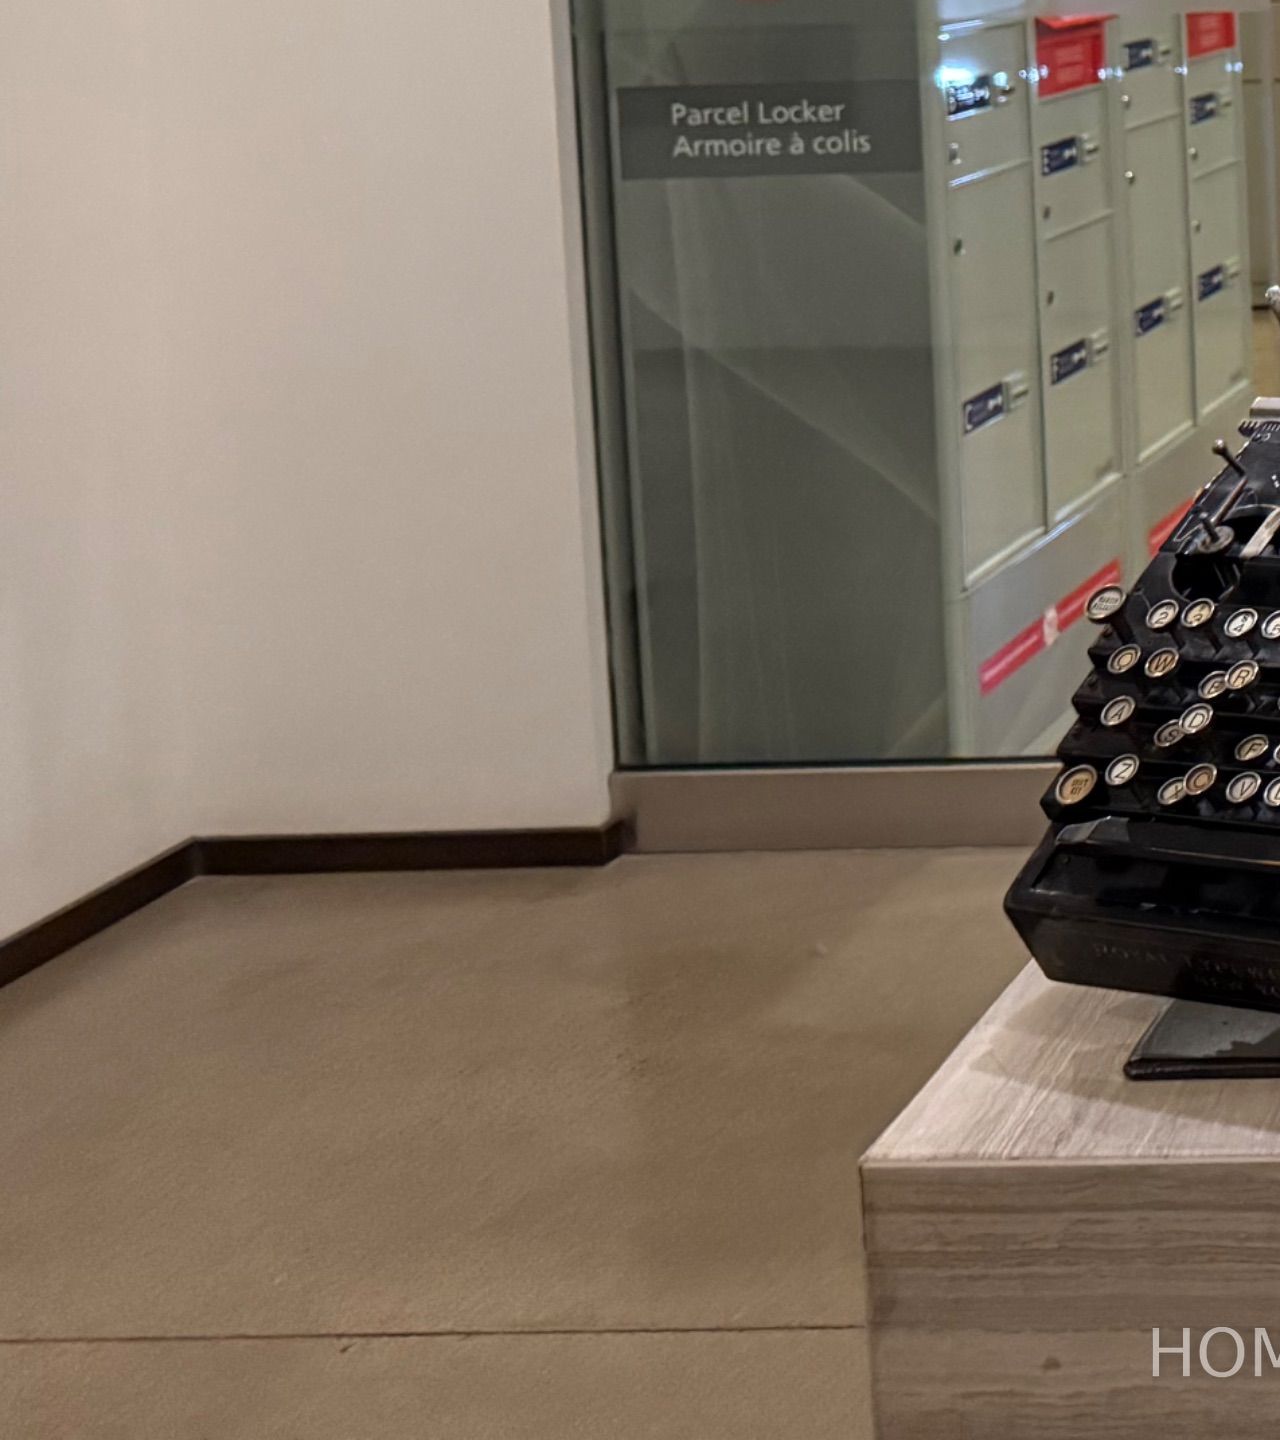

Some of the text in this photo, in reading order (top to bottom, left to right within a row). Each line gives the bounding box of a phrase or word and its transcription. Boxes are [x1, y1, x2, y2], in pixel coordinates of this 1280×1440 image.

[671, 98, 846, 126] Parcel Locker
[672, 128, 872, 158] Armoire à colis
[1155, 612, 1168, 624] 2
[1156, 654, 1176, 672] W
[1232, 669, 1250, 686] R
[1112, 706, 1127, 722] A
[1188, 713, 1206, 729] D
[1243, 742, 1263, 758] F
[1116, 763, 1133, 779] Z
[1193, 771, 1208, 787] C
[1239, 781, 1255, 798] V
